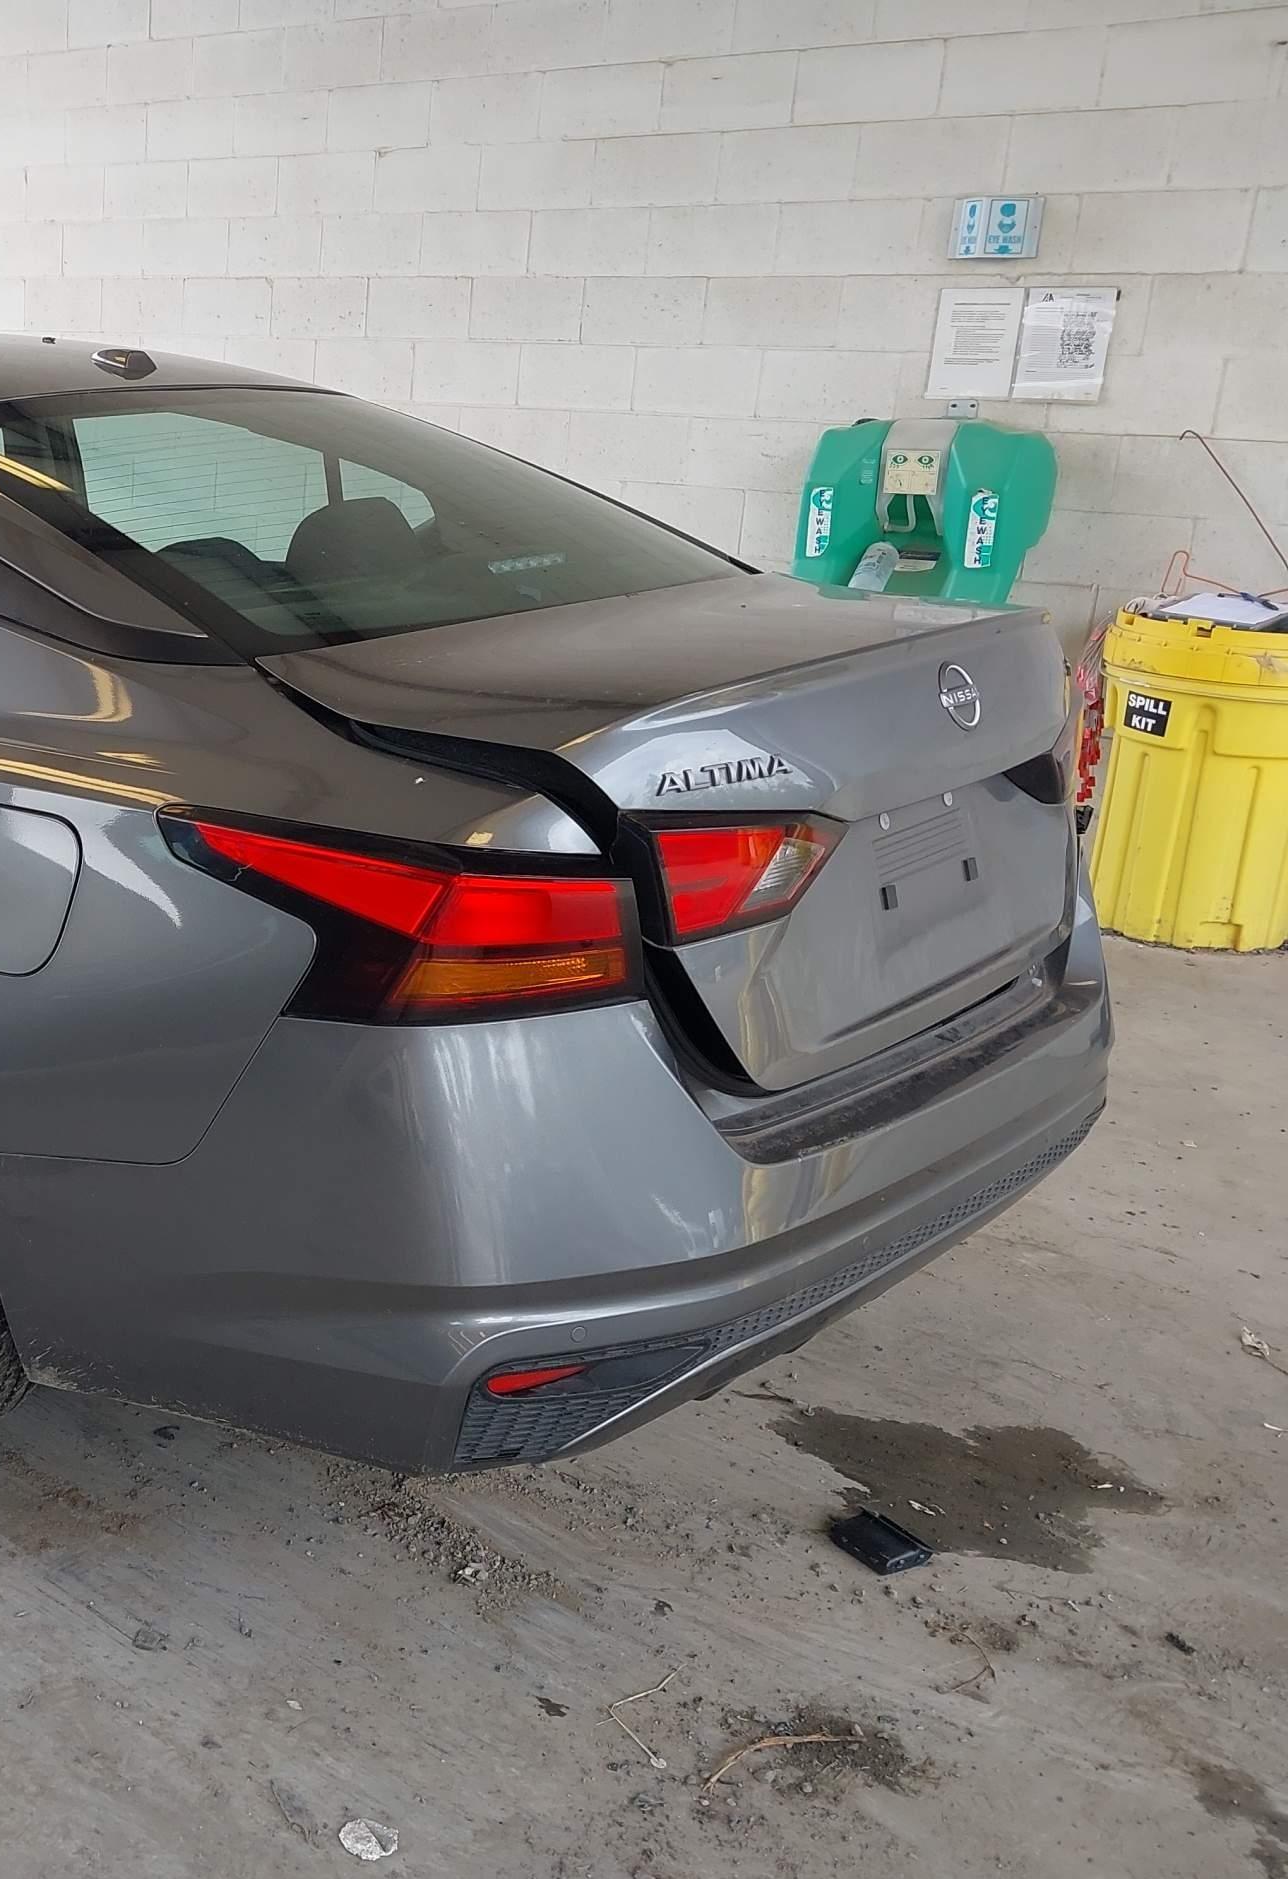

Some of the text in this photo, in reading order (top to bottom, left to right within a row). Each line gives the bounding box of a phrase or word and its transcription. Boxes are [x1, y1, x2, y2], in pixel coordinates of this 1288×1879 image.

[1128, 693, 1167, 715] SPILL
[1131, 714, 1157, 732] KIT
[656, 753, 793, 797] ALTIMA
